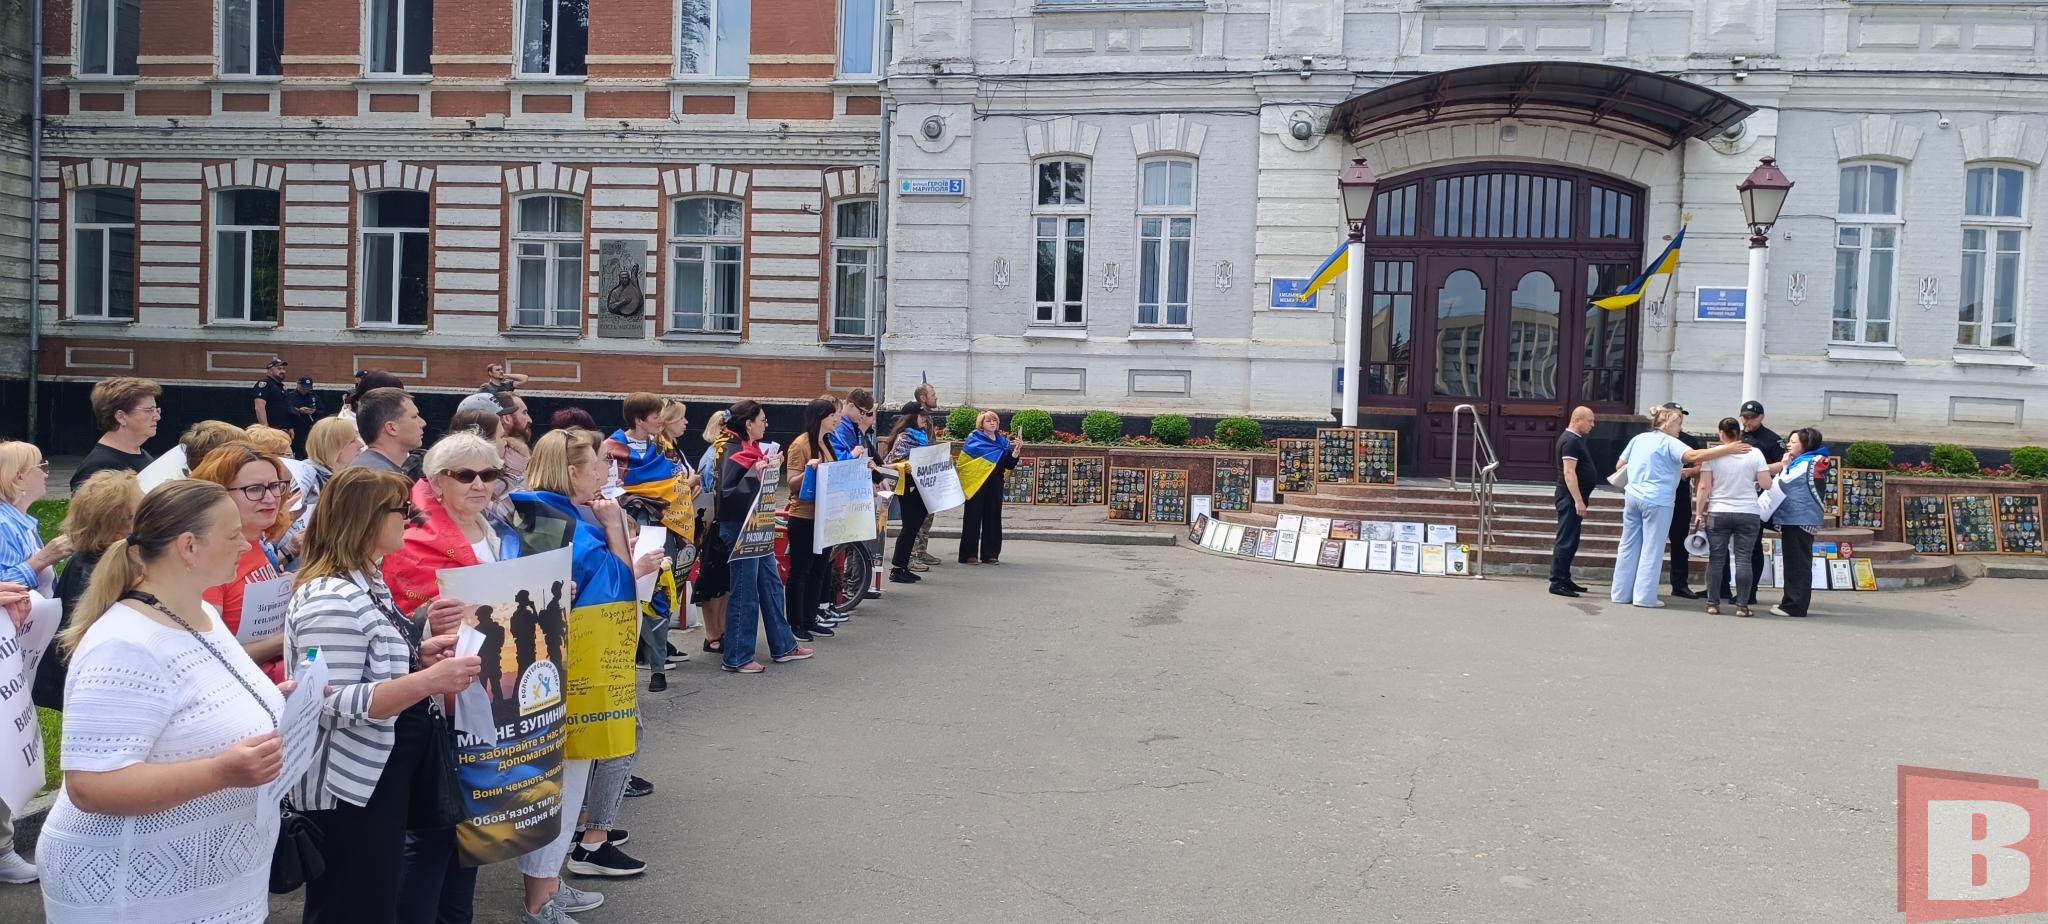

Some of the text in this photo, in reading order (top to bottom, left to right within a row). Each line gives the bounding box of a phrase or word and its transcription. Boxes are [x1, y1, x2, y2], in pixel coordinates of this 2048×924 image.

[951, 180, 960, 192] 3
[495, 723, 515, 740] НЕ
[520, 703, 567, 734] ЗУПИНИ
[581, 708, 638, 725] ОБОРОНИ
[458, 754, 476, 764] Не
[480, 739, 538, 760] забирайте
[547, 729, 559, 740] нас
[498, 743, 555, 772] допомагати
[472, 788, 503, 800] Вони
[505, 774, 544, 792] чекають
[536, 795, 555, 809] тилу
[515, 811, 548, 830] щодня
